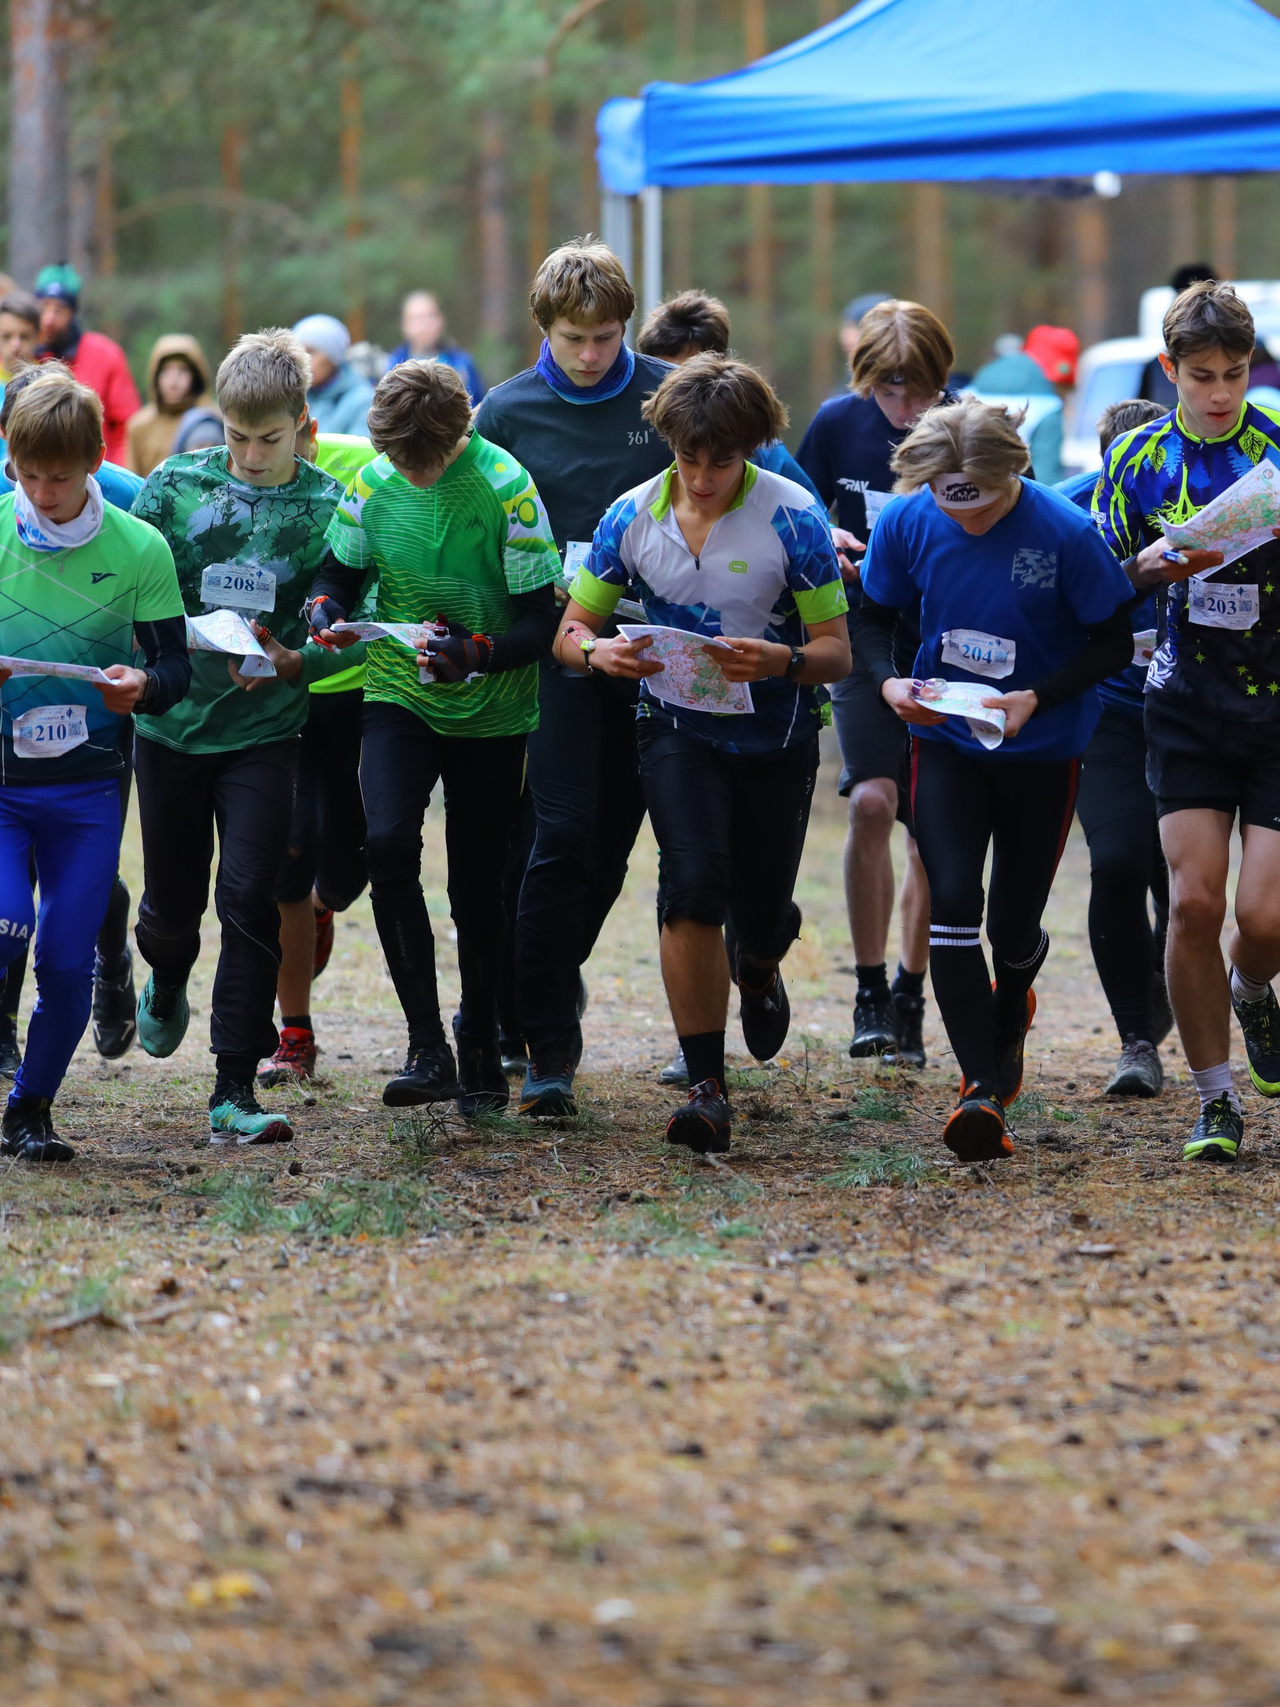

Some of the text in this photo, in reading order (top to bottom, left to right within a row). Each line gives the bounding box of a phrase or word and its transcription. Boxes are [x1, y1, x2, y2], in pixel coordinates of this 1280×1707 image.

[223, 576, 255, 592] 208
[1206, 597, 1237, 615] 203
[961, 644, 992, 664] 204
[34, 723, 67, 742] 210
